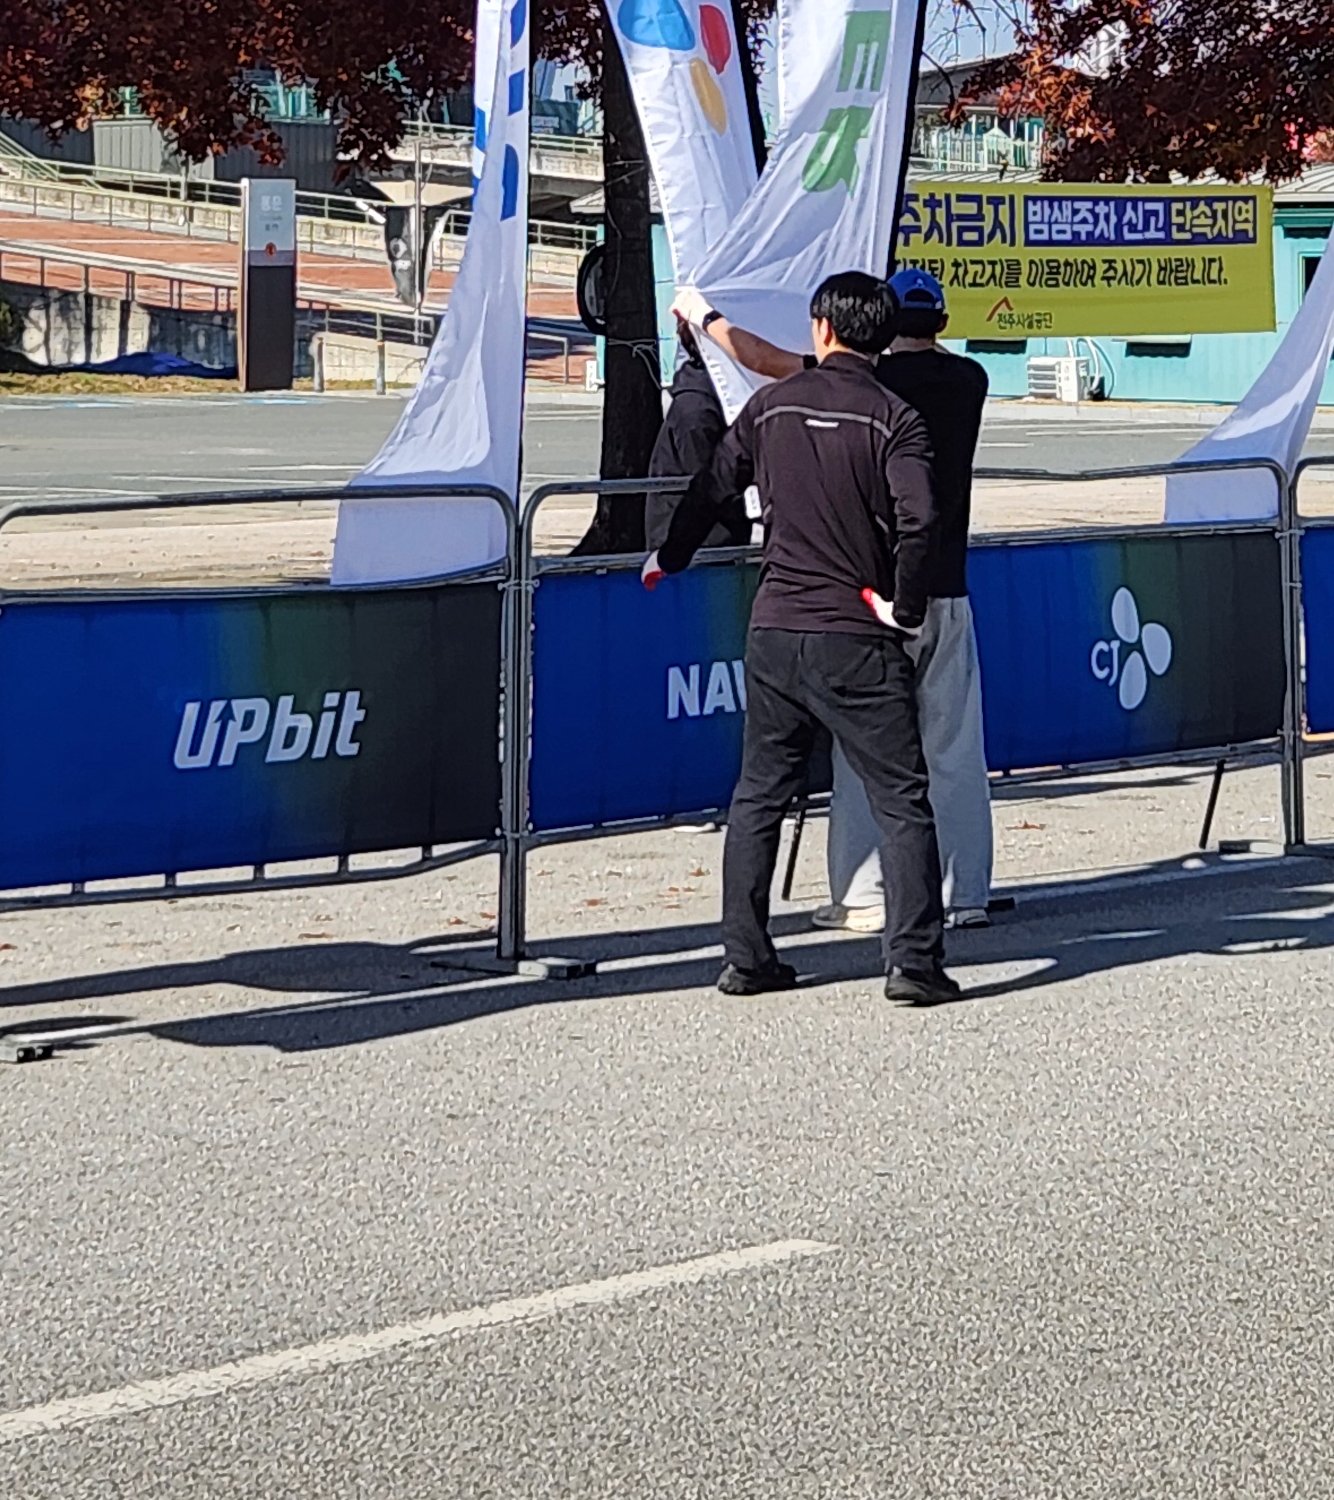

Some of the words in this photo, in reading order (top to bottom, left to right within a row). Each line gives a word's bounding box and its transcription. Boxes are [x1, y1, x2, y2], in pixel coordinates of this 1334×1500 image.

[898, 192, 1016, 247] 주차금지
[1027, 199, 1117, 241] 밤샘주차
[1122, 200, 1166, 240] 신고
[1171, 199, 1254, 240] 단속지역
[949, 257, 1023, 289] 차고지를
[1026, 257, 1097, 289] 이용하여
[1100, 257, 1153, 288] 주시기
[1156, 255, 1229, 288] 바랍니다.
[1090, 639, 1121, 687] CJ
